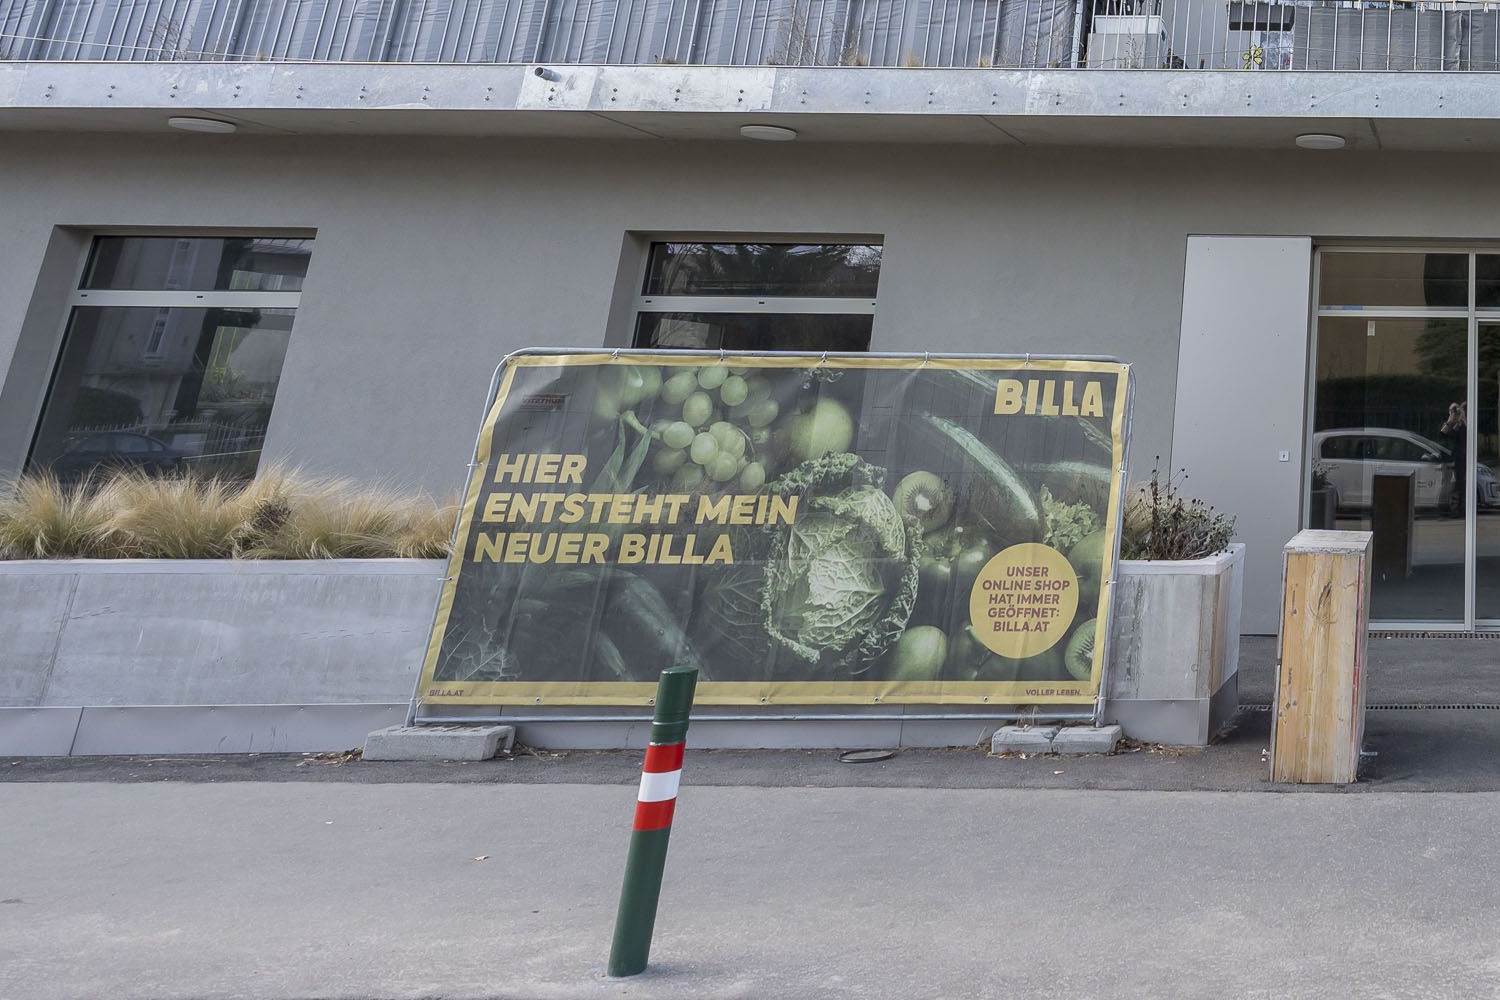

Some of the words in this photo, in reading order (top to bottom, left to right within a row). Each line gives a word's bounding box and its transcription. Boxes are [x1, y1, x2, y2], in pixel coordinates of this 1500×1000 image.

[994, 379, 1103, 417] BILLA
[493, 453, 587, 484] HIER
[481, 492, 689, 525] ENTSTEHT
[694, 494, 799, 525] MEIN
[472, 532, 610, 565] NEUER
[617, 533, 734, 565] BILLA
[1006, 566, 1049, 577] UNSER
[982, 580, 1031, 591] ONLINE
[1034, 580, 1070, 591] SHOP
[988, 593, 1014, 605] HAT
[1017, 593, 1060, 605] IMMER
[987, 604, 1060, 618] GEÖFFNET:
[993, 621, 1050, 632] BILLA.AT
[1025, 689, 1055, 697] VOLLER
